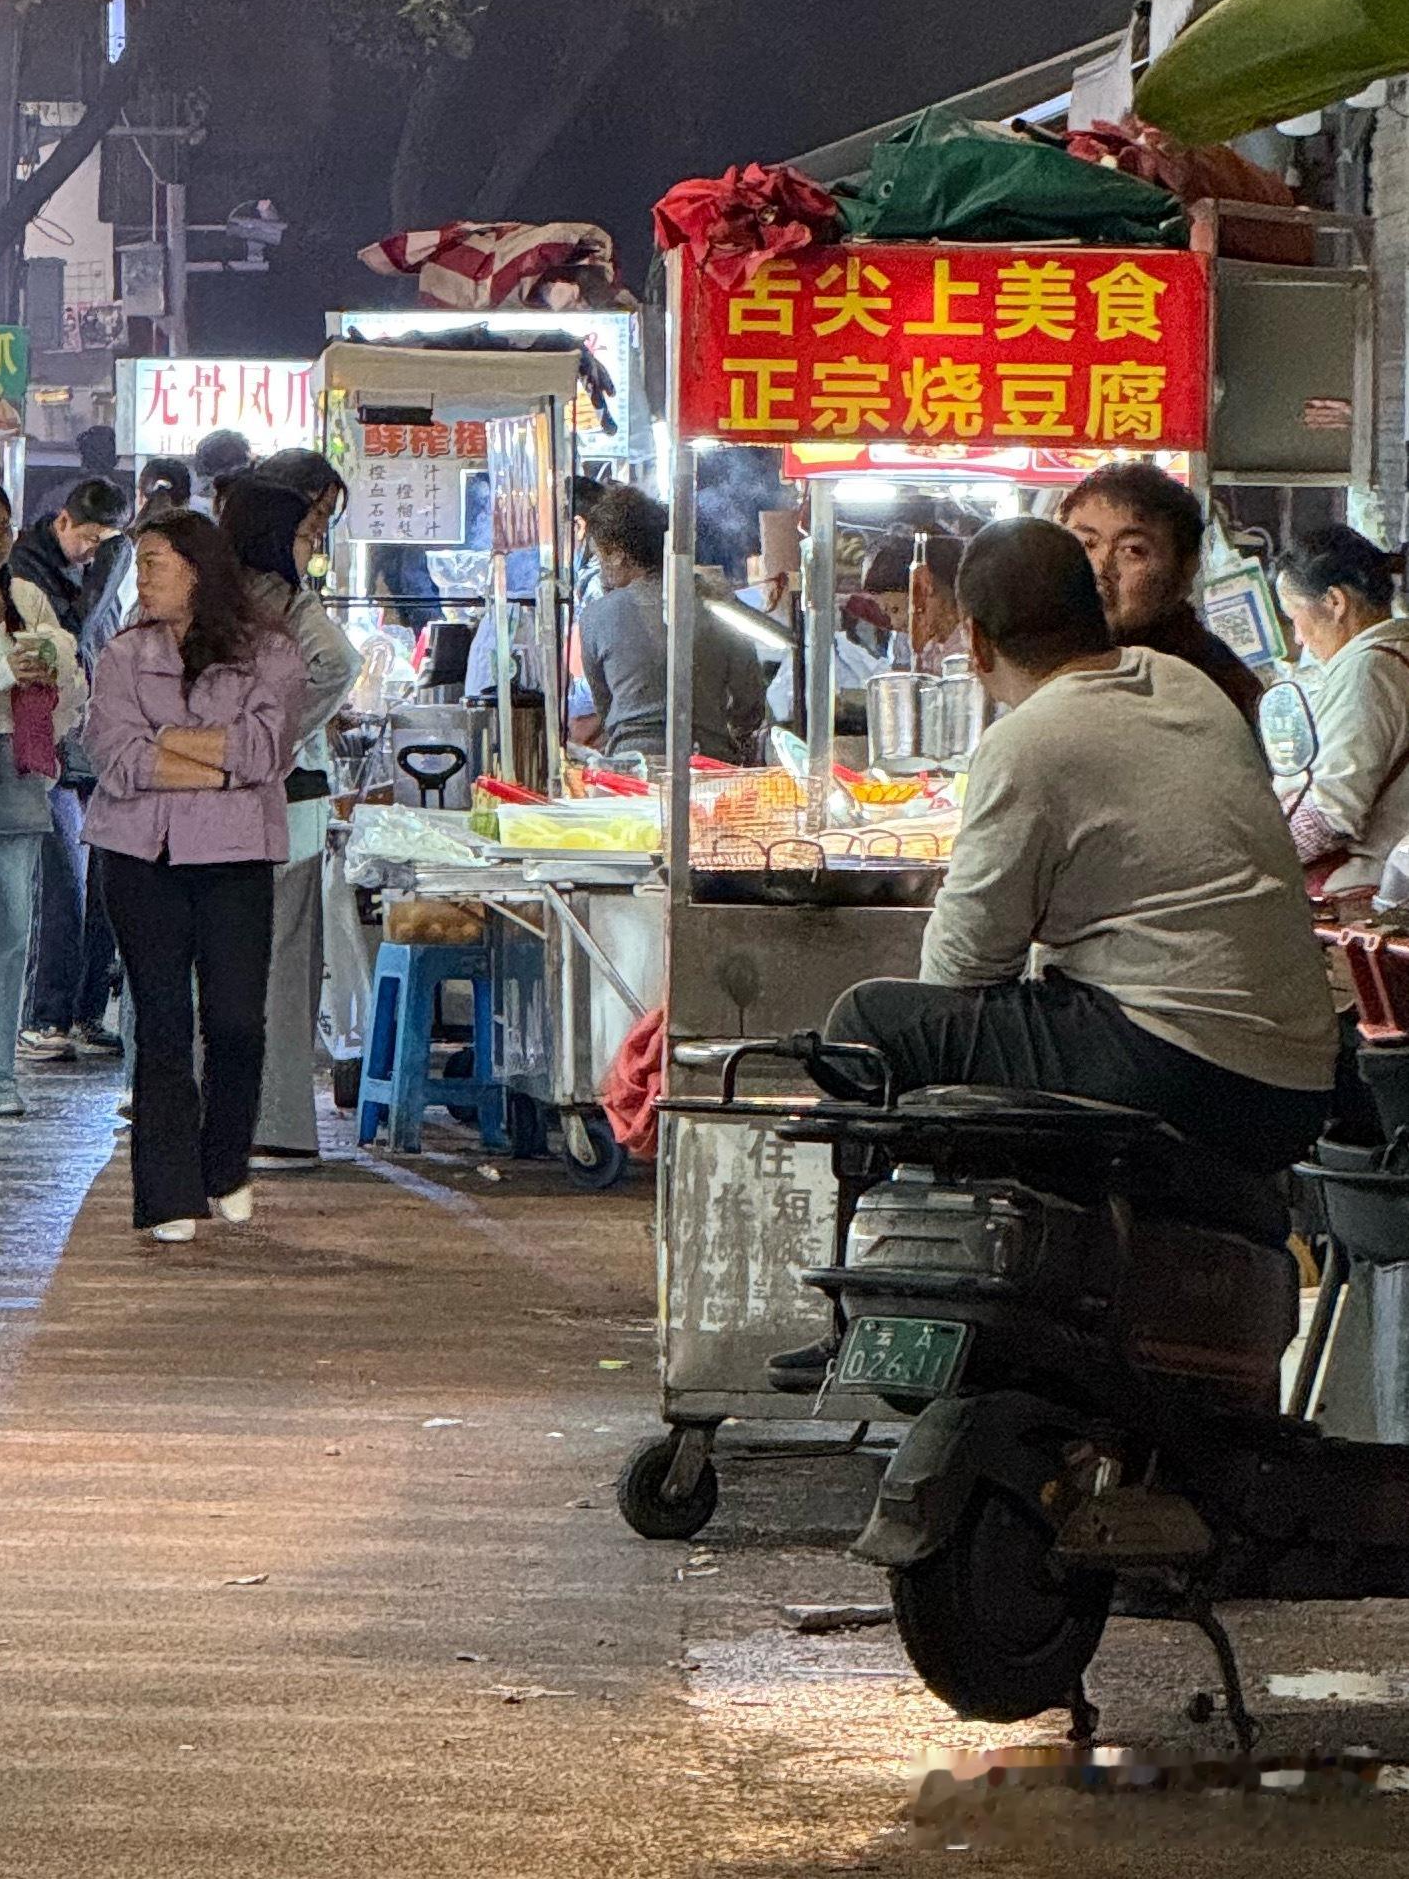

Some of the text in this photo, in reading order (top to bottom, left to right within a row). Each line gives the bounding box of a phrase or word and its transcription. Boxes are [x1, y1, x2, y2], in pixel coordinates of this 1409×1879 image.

[727, 258, 1167, 343] 舌尖上美食
[720, 356, 1165, 441] 正宗烧豆腐
